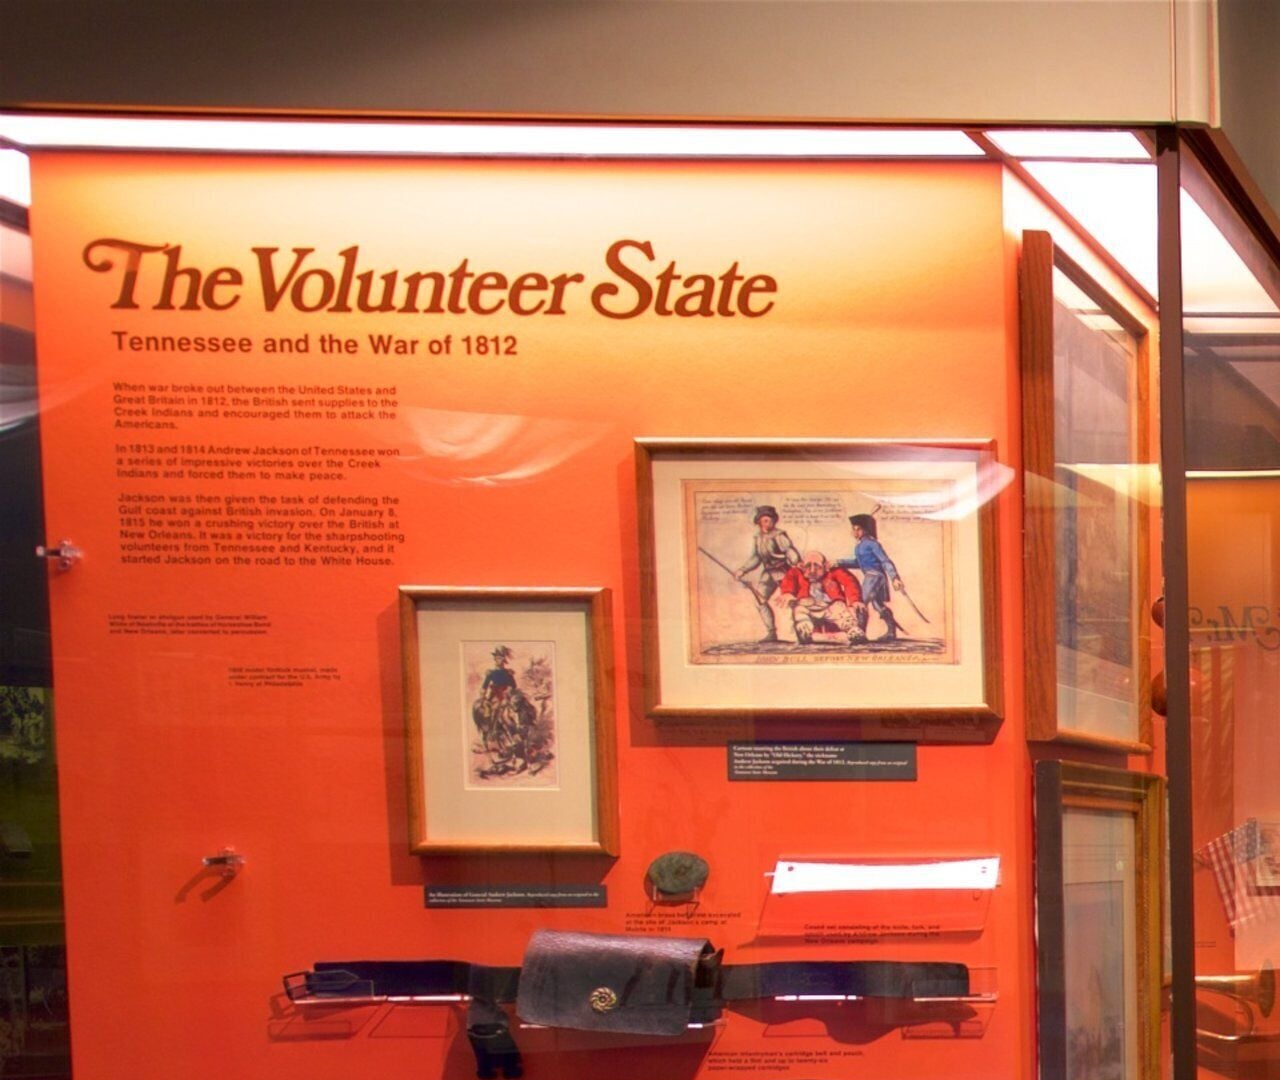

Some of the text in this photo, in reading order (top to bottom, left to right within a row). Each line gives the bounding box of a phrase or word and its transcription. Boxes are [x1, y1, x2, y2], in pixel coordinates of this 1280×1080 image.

[83, 238, 778, 320] The Volunteer State
[111, 330, 518, 356] Tennessee and the War of 1812
[112, 381, 396, 395] When war broke out between the United States and
[112, 393, 145, 405] Great
[147, 394, 184, 405] Britain
[187, 394, 197, 405] in
[231, 395, 250, 406] the
[252, 395, 288, 406] British
[291, 395, 315, 406] sent
[318, 395, 364, 409] supplies
[367, 396, 378, 407] to
[380, 396, 398, 407] the
[113, 405, 396, 421] Creek Indians and encouraged them to attack the
[115, 442, 399, 456] In 1813 and 1814 Andrew Jackson of Tennessee won
[116, 455, 380, 469] a series of impressive victories over the Creek
[116, 467, 159, 478] Indians
[162, 468, 184, 479] and
[187, 468, 224, 479] forced
[227, 468, 256, 479] them
[259, 468, 270, 479] to
[274, 469, 305, 480] make
[118, 491, 399, 507] Jackson was then given the task of defending the
[118, 504, 142, 515] Gulf
[145, 504, 176, 515] coast
[180, 504, 222, 518] against
[225, 505, 262, 516] British
[319, 505, 336, 516] On
[338, 506, 384, 520] January
[120, 516, 399, 531] 1815 he won a crushing victory over the British at
[119, 528, 145, 539] New
[198, 529, 206, 540] It
[210, 532, 232, 540] was
[235, 532, 242, 540] a
[246, 529, 283, 543] victory
[286, 529, 301, 540] for
[304, 529, 322, 540] the
[325, 530, 405, 544] sharpshooting
[120, 540, 394, 556] volunteers from Tennessee and Kentucky, and it
[120, 553, 161, 564] started
[164, 553, 211, 564] Jackson
[214, 556, 230, 564] on
[232, 553, 251, 564] the
[254, 553, 280, 564] road
[283, 554, 295, 564] to
[297, 554, 316, 565] the
[320, 554, 352, 565] White
